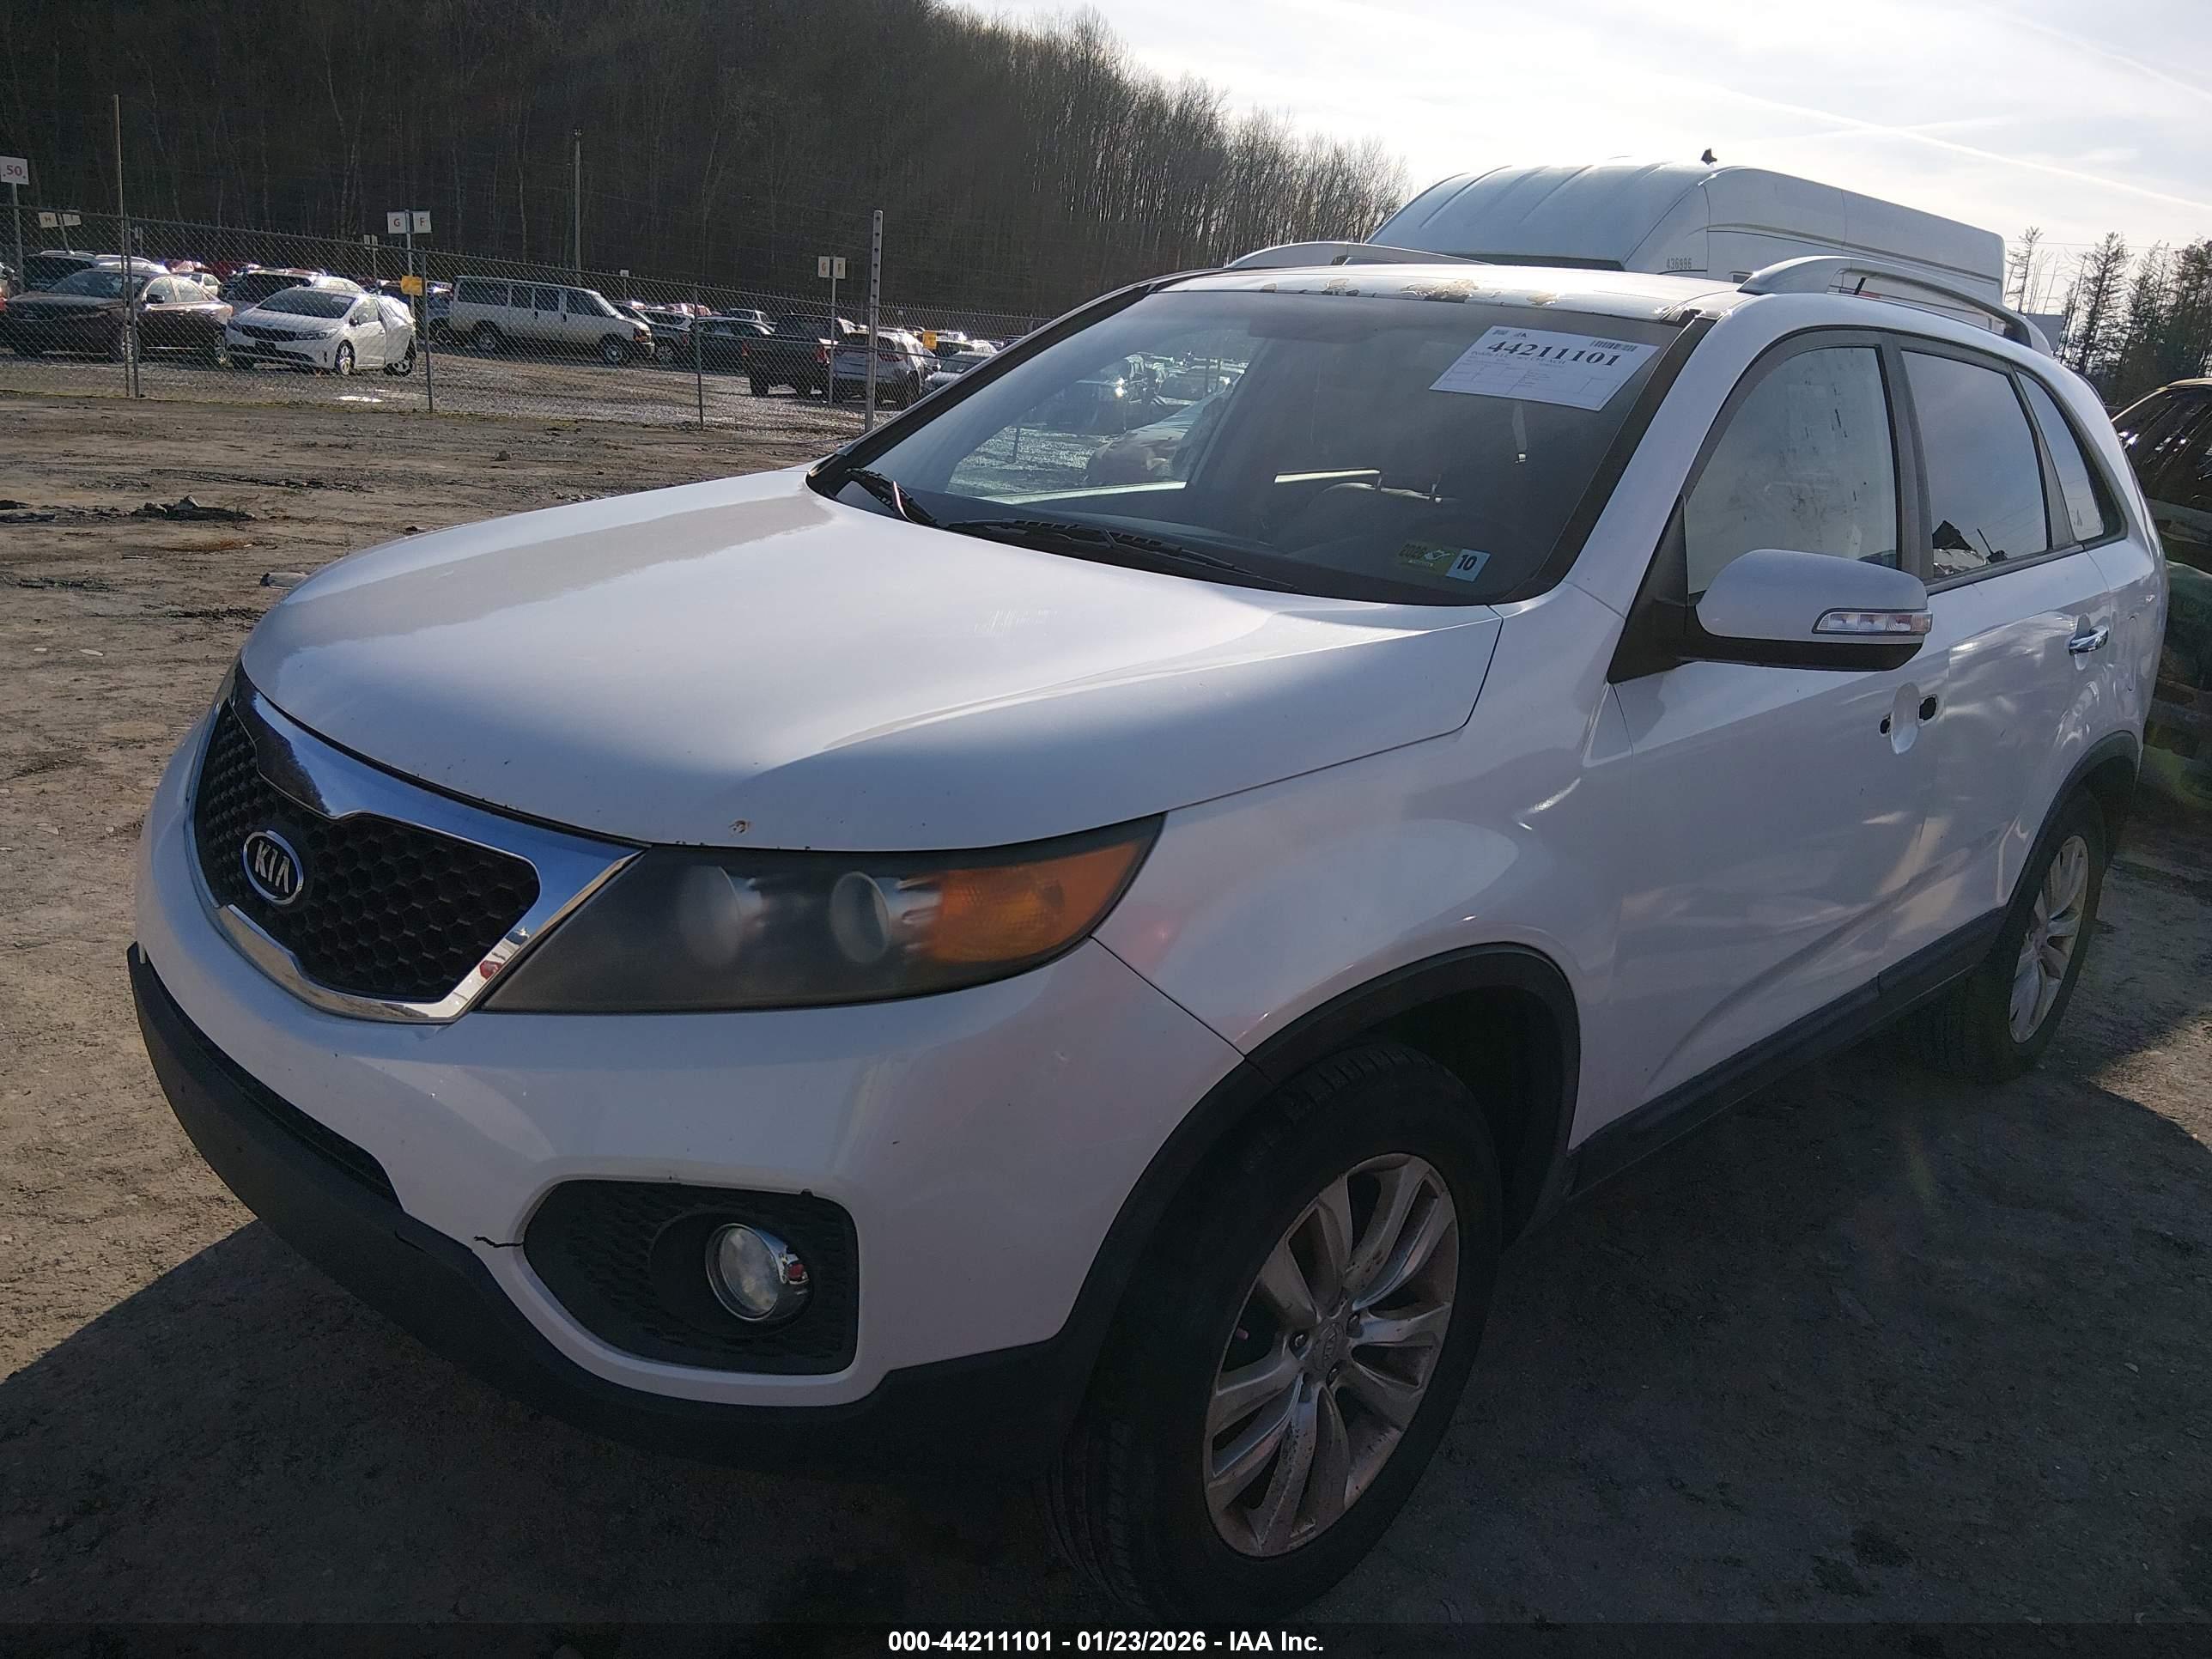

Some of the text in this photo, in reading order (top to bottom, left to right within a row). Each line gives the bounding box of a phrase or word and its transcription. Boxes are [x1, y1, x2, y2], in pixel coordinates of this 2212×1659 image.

[6, 164, 22, 176] 50
[393, 217, 401, 228] G
[419, 216, 426, 227] F
[1486, 340, 1622, 366] 44211101
[1456, 554, 1478, 571] 10
[254, 839, 290, 894] KIA
